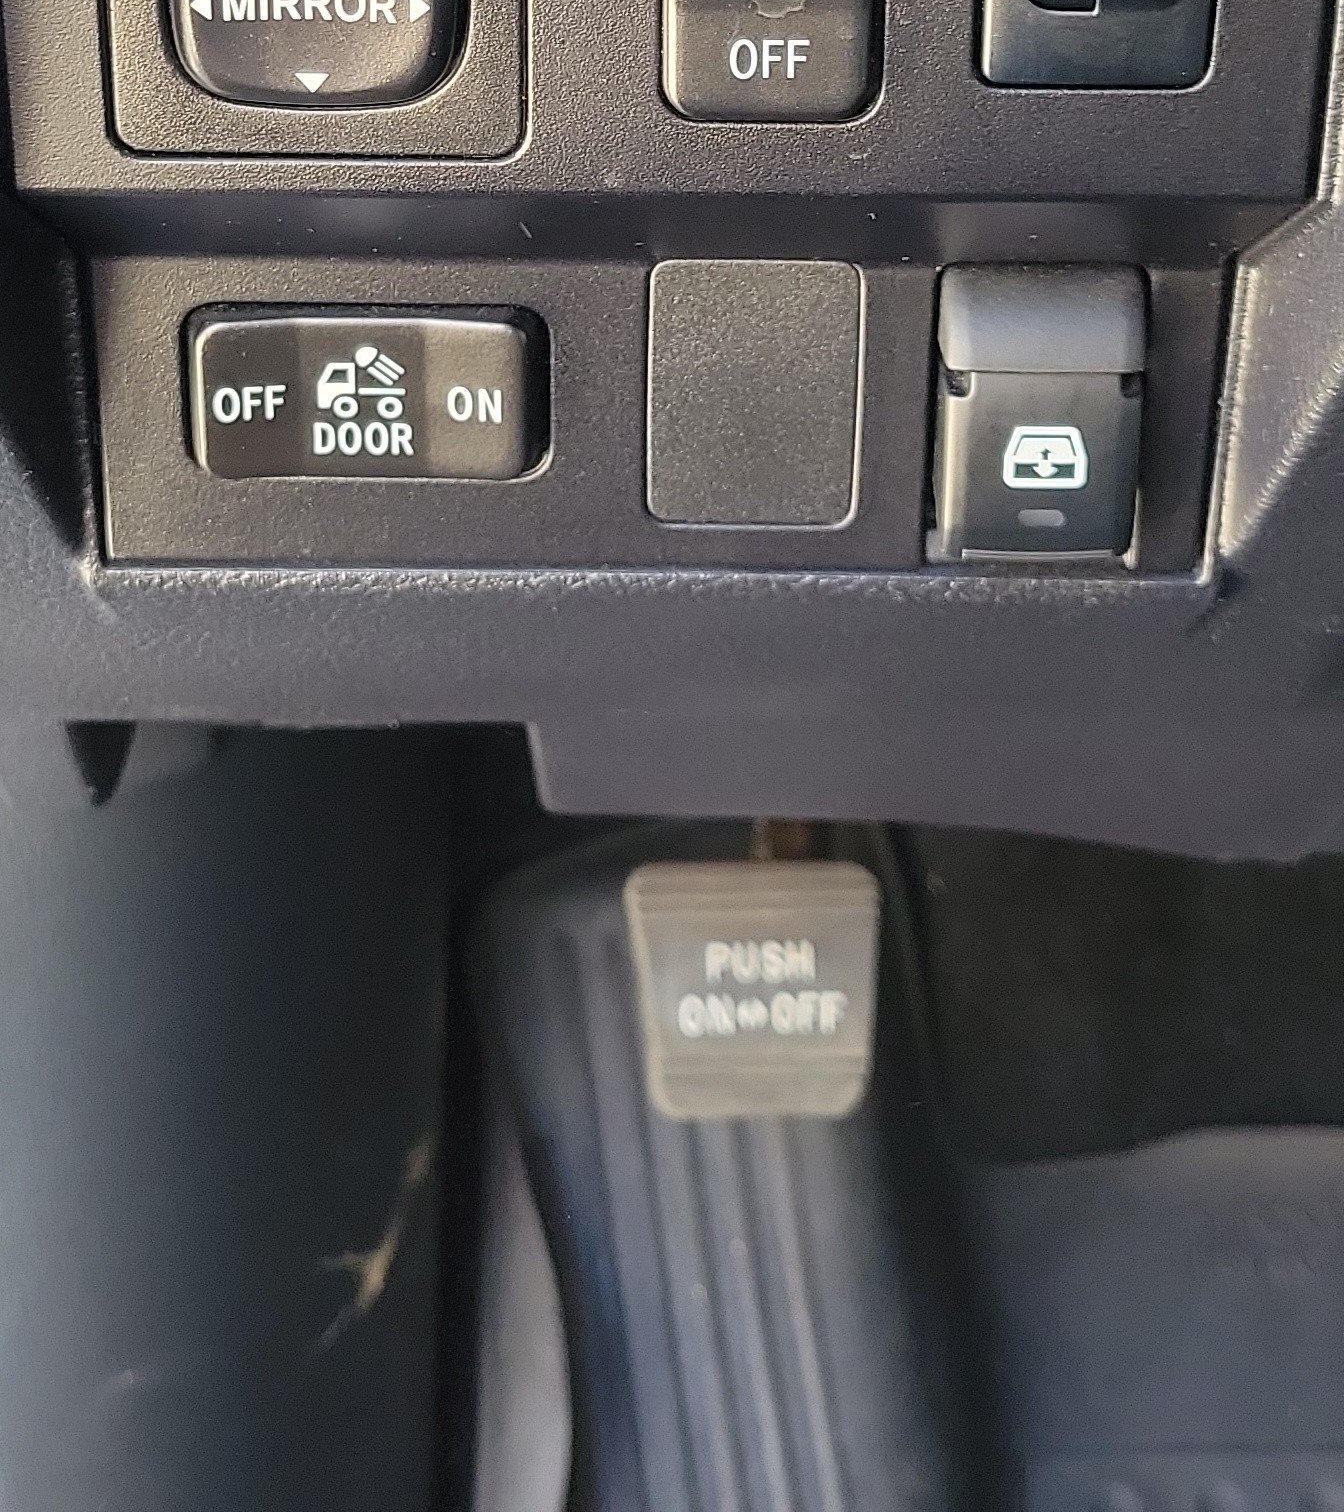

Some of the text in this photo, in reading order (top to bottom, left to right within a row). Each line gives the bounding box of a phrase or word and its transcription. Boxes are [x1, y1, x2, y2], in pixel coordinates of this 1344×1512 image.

[729, 38, 811, 80] OFF
[212, 385, 502, 424] OFF ON
[312, 422, 414, 456] DOOR
[705, 939, 816, 984] PUSH
[678, 990, 848, 1037] ON OFF
